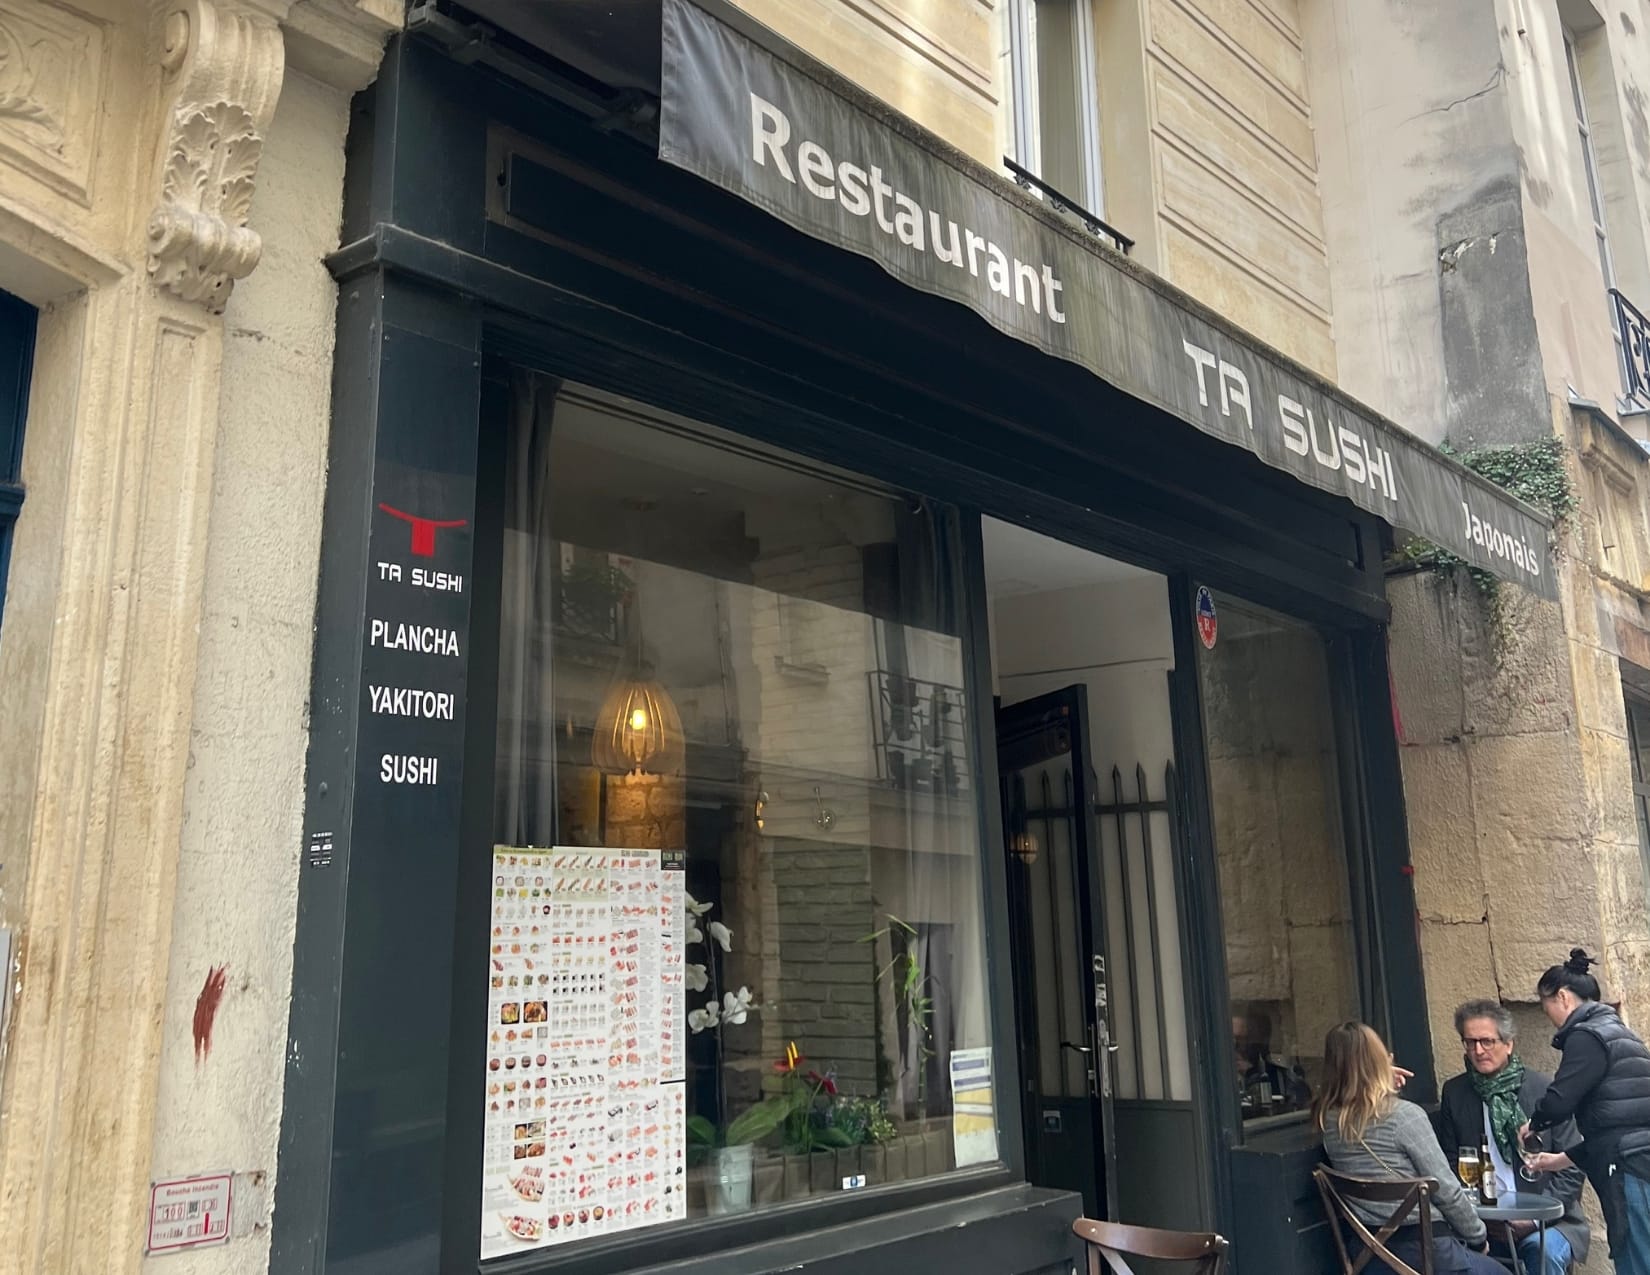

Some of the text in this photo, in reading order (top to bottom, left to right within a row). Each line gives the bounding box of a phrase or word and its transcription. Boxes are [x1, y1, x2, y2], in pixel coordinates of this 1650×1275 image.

[750, 92, 1539, 576] Restaurant TA SUSHI Japonais
[377, 561, 463, 593] TA SUSHI
[370, 619, 460, 657] PLANCHA
[368, 685, 455, 720] YAKITORI
[380, 754, 438, 785] SUSHI
